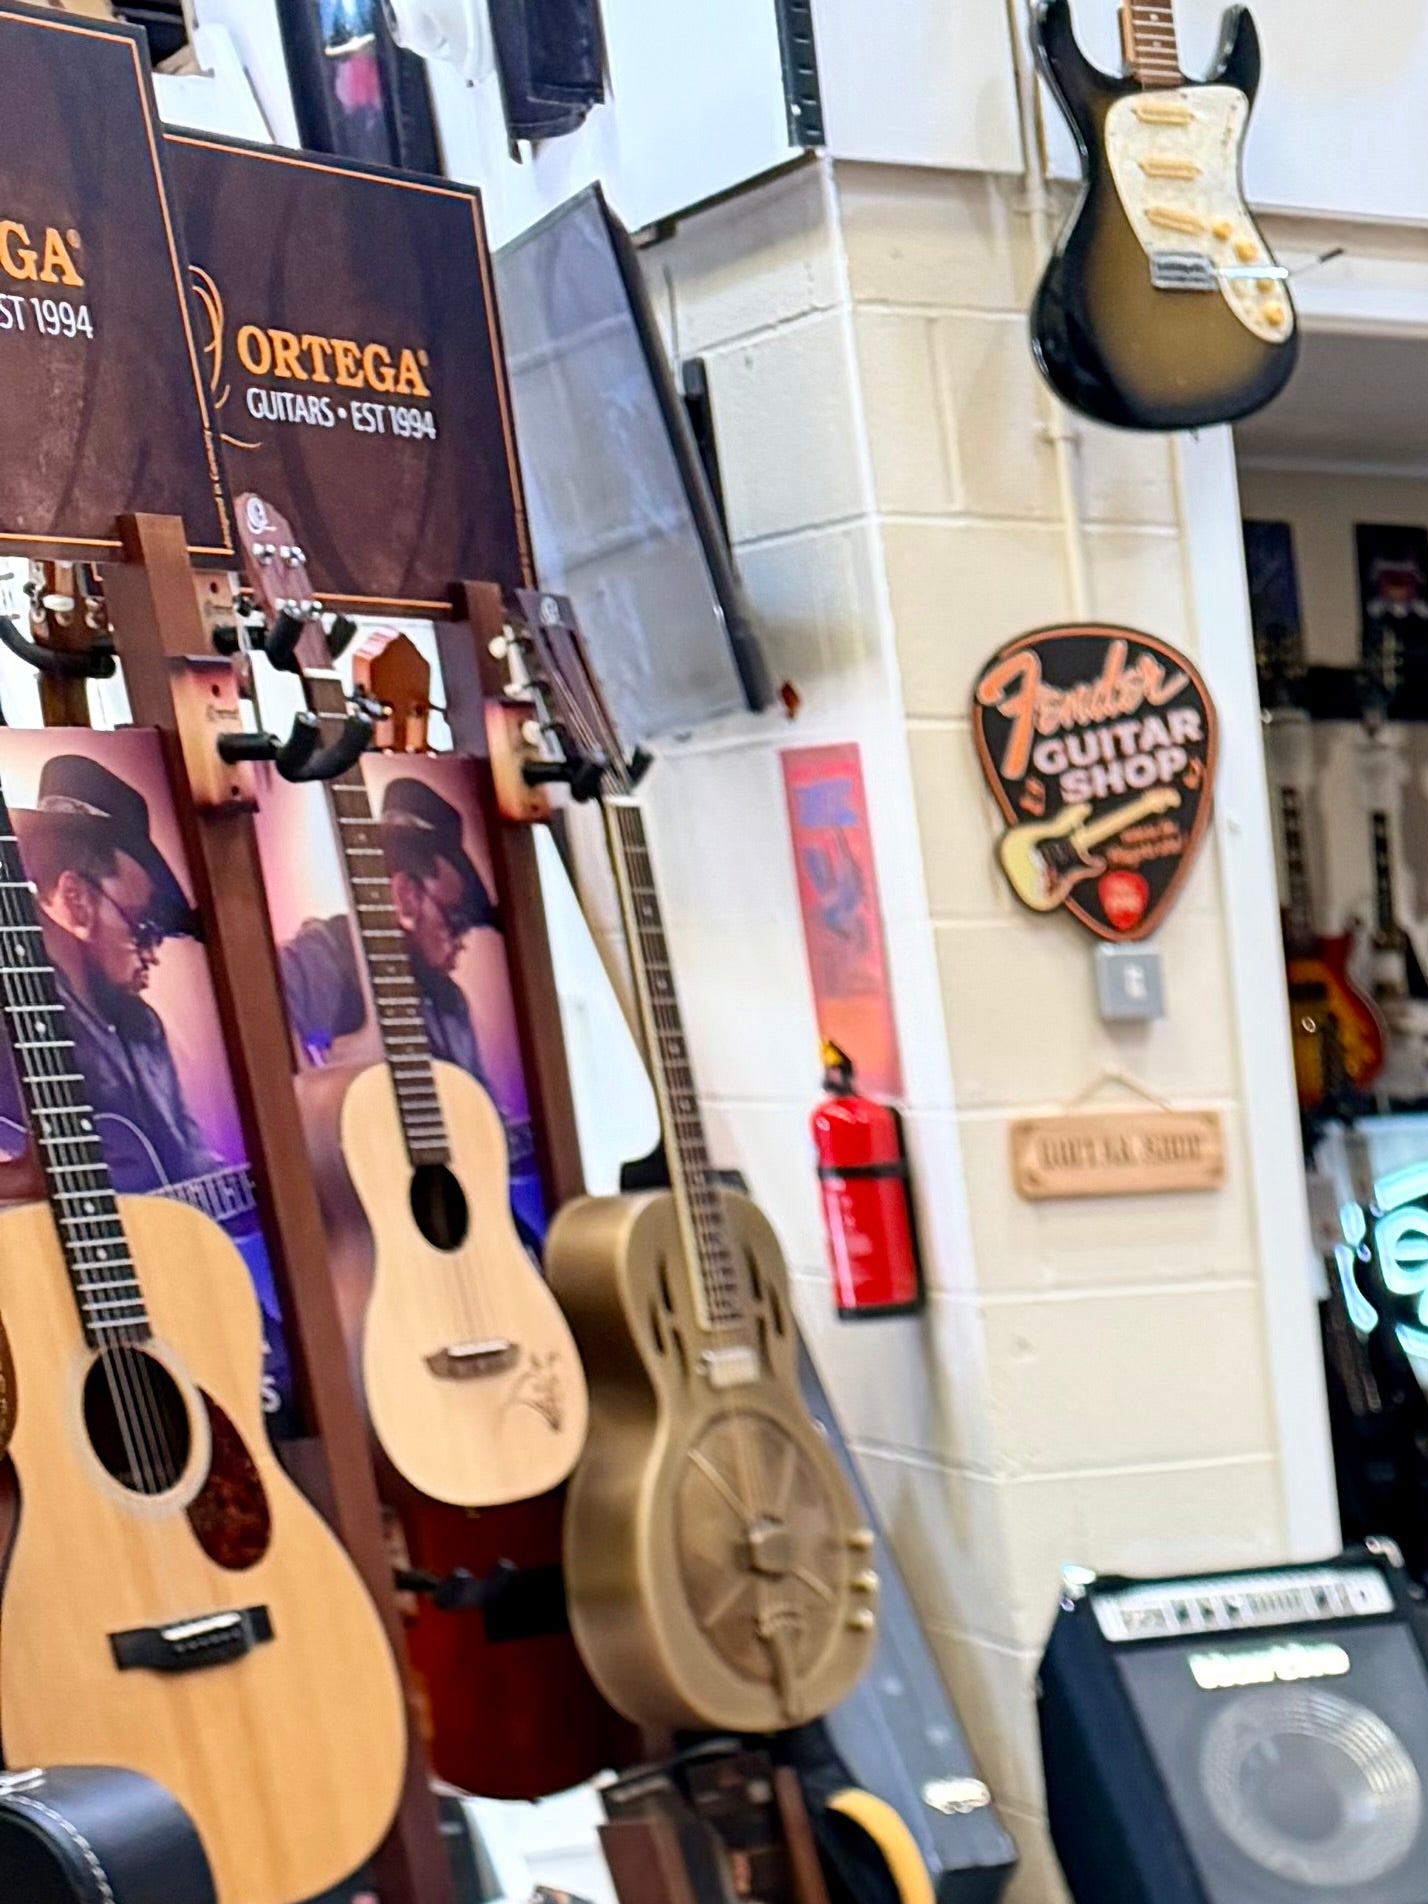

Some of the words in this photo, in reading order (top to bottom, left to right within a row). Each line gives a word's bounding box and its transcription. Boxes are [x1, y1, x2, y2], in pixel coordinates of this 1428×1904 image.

[30, 299, 93, 339] 1994
[236, 324, 431, 398] ORTEGA
[246, 386, 334, 428] GUITARS
[352, 401, 386, 434] EST
[391, 406, 437, 440] 1994
[976, 639, 1190, 780] Fender
[1032, 707, 1202, 775] GUITAR
[1059, 747, 1188, 803] SHOP
